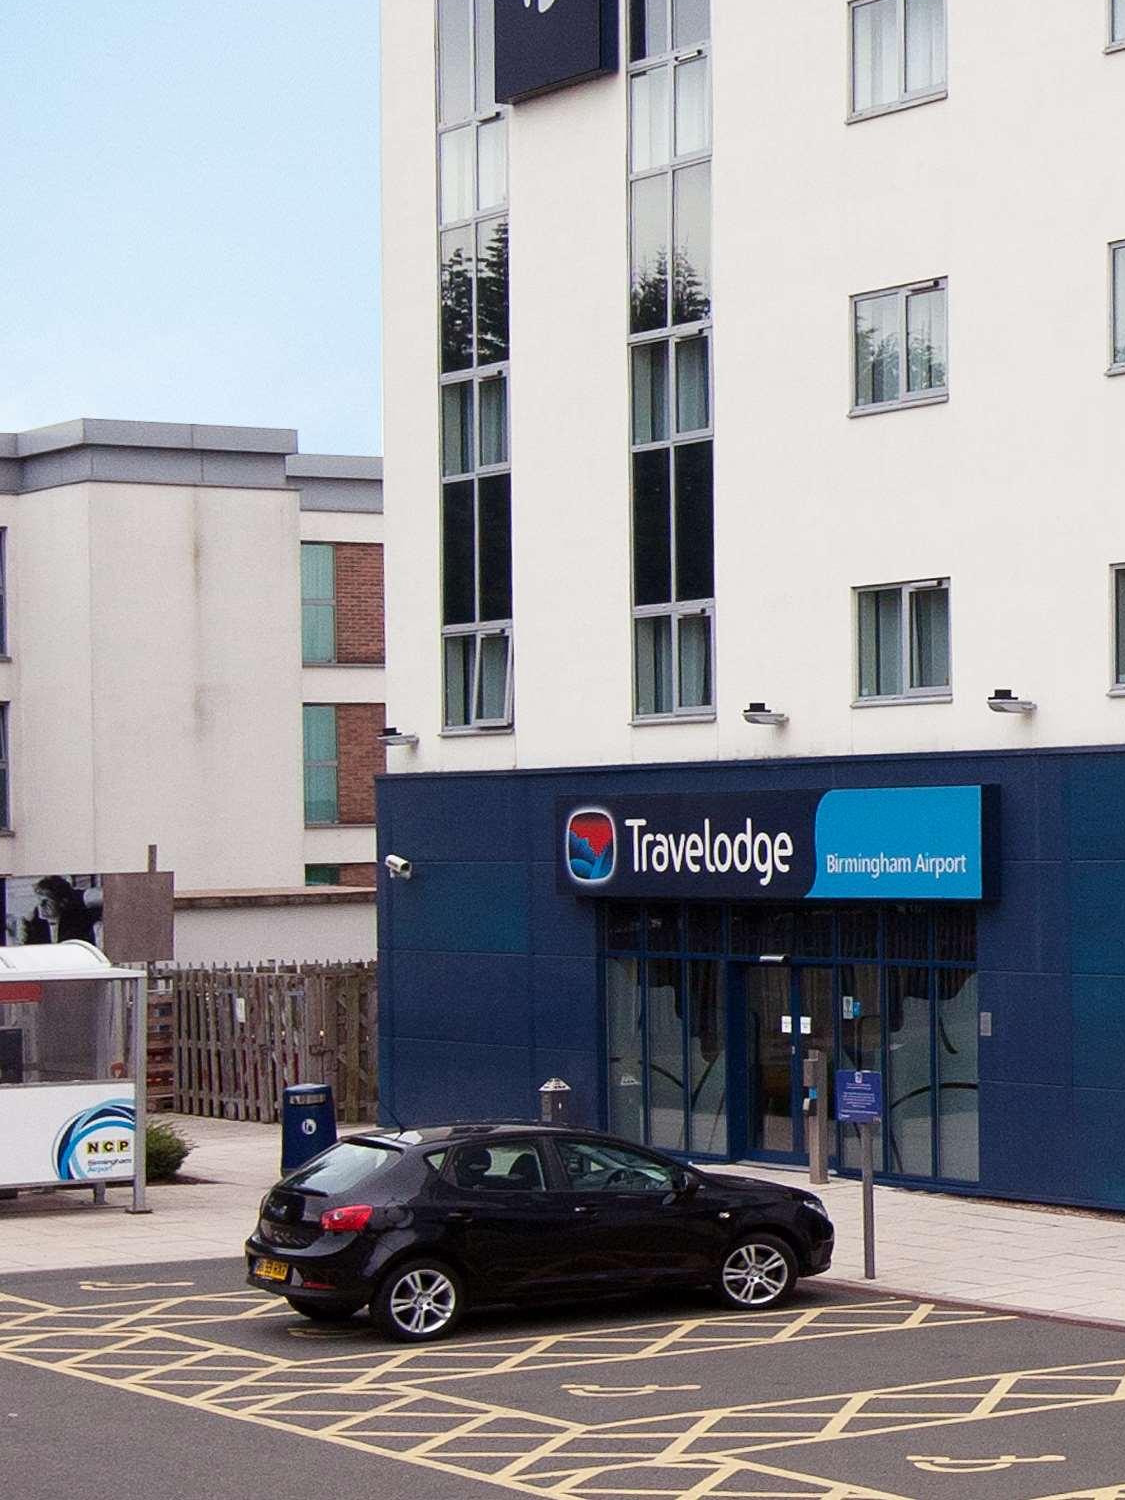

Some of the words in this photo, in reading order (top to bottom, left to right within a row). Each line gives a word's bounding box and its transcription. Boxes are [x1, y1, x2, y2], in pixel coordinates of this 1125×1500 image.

[625, 818, 794, 886] Travelodge
[826, 852, 912, 879] Birmingham
[915, 852, 967, 878] Airport
[86, 1140, 129, 1154] NCP
